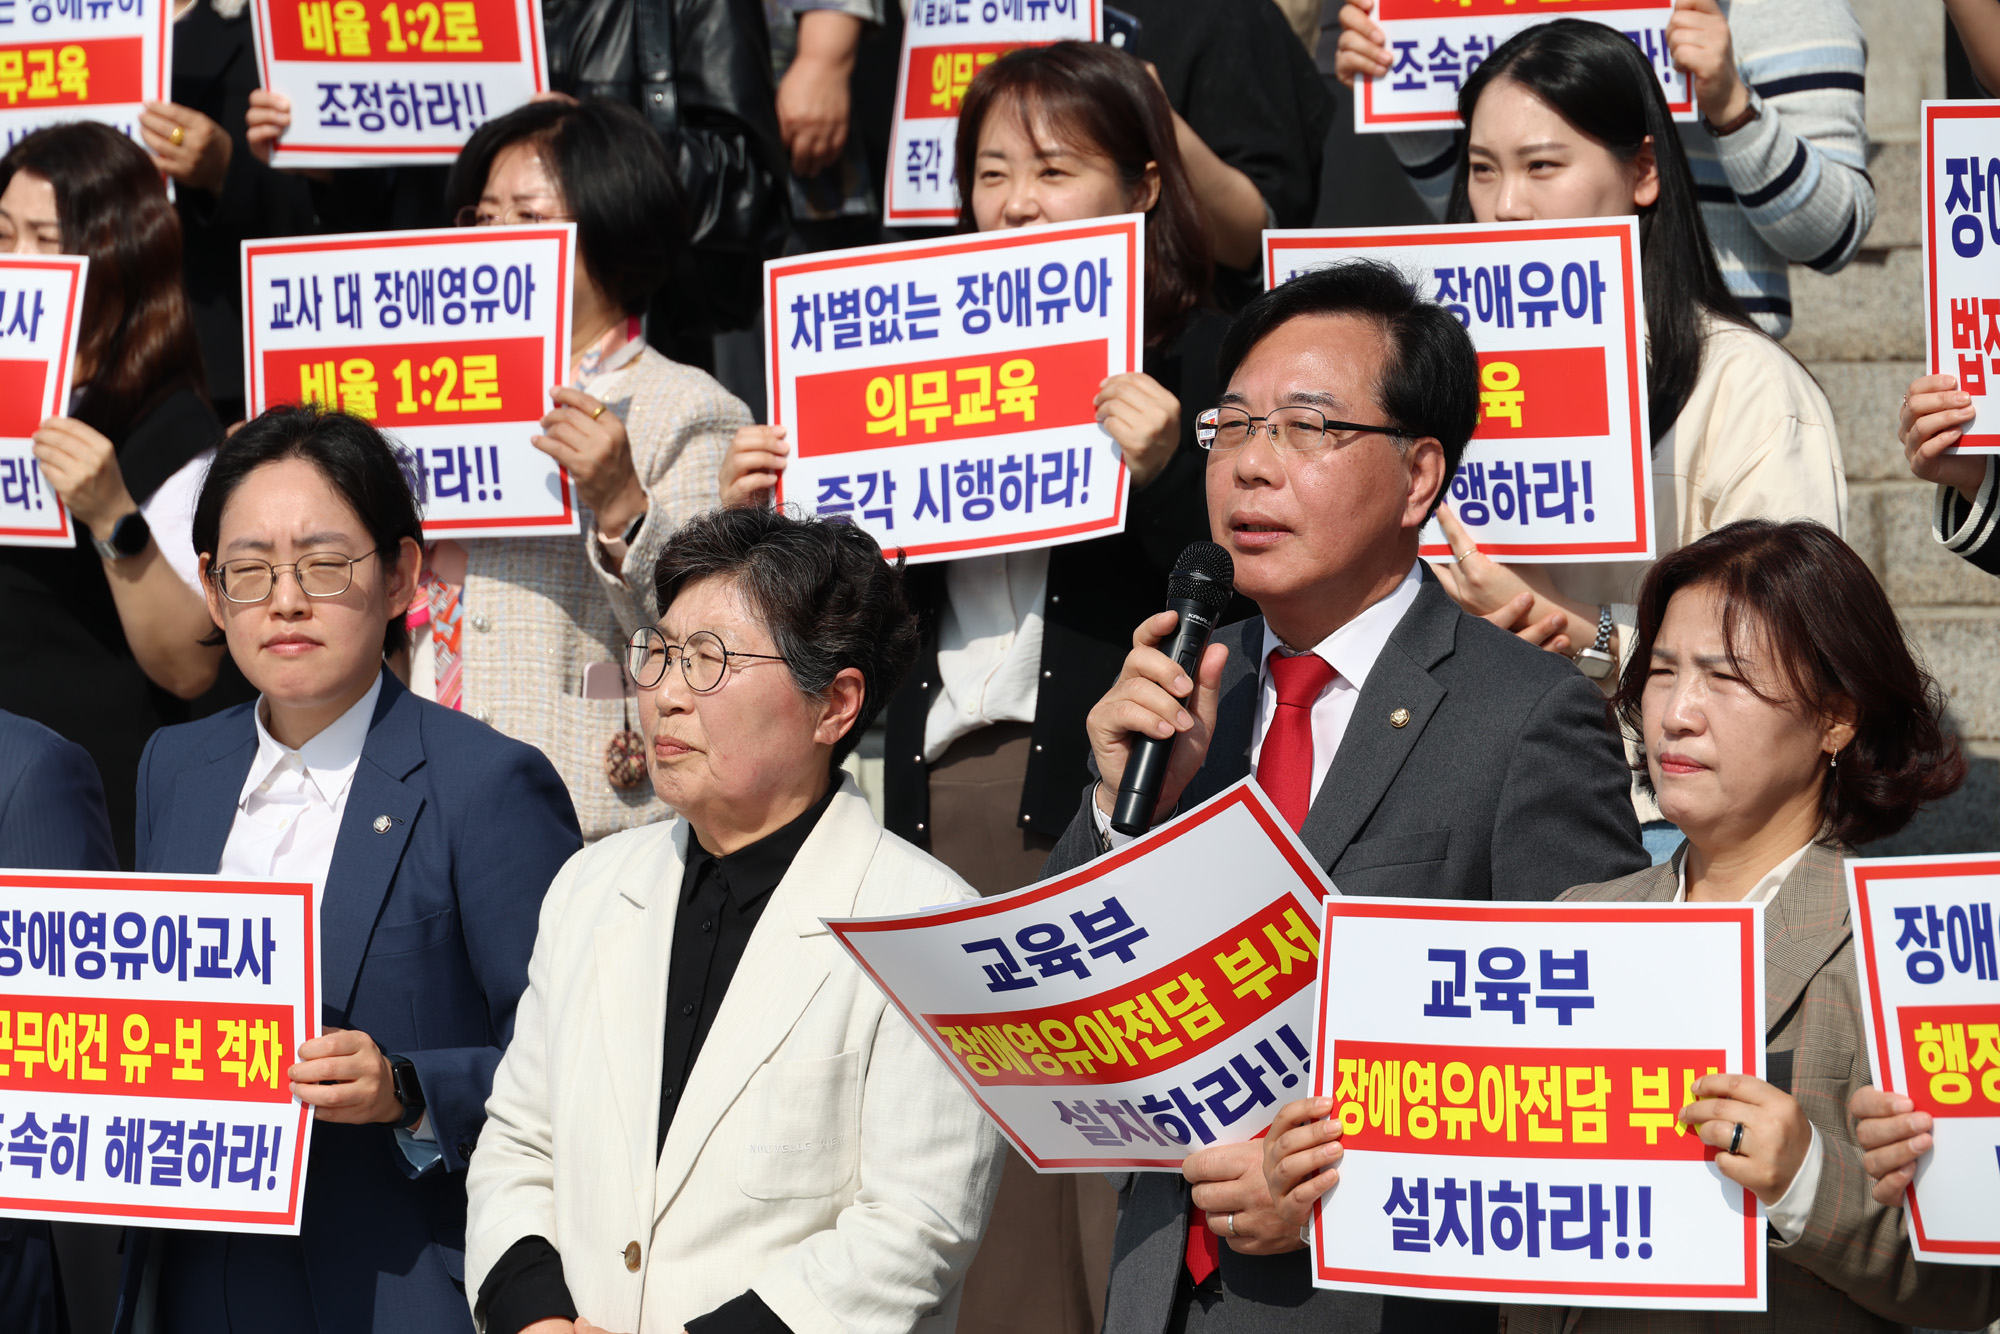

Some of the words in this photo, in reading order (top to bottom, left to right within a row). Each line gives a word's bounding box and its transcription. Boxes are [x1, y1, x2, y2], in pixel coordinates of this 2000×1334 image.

[299, 0, 371, 56] 비율
[382, 2, 483, 52] 1:2로
[317, 82, 486, 132] 조정하라!!
[907, 139, 942, 192] 즉각
[270, 275, 323, 332] 교사
[333, 273, 362, 329] 대
[374, 263, 536, 329] 장애영유아
[790, 281, 941, 353] 차별없는
[956, 257, 1113, 335] 장애유아
[1433, 260, 1606, 329] 장애유아
[300, 358, 379, 420] 비율
[393, 355, 502, 414] 1:2로
[866, 359, 1039, 437] 의무교육
[816, 470, 897, 530] 즉각
[912, 447, 1092, 524] 시행하라!
[1430, 459, 1595, 527] 행하라!
[961, 896, 1150, 993] 교육부
[1893, 902, 2000, 985] 장애
[936, 971, 1226, 1078] 장애영유아전담
[1213, 907, 1320, 1001] 부서
[1423, 946, 1595, 1026] 교육부
[120, 1013, 205, 1084] 유-보
[216, 1019, 283, 1089] 격차
[1053, 1023, 1310, 1147] 설치하라!!
[1335, 1058, 1612, 1143] 장애영유아전담
[0, 1111, 90, 1182] 속히
[104, 1116, 283, 1191] 해결하라!
[1382, 1176, 1653, 1260] 설치하라!!
